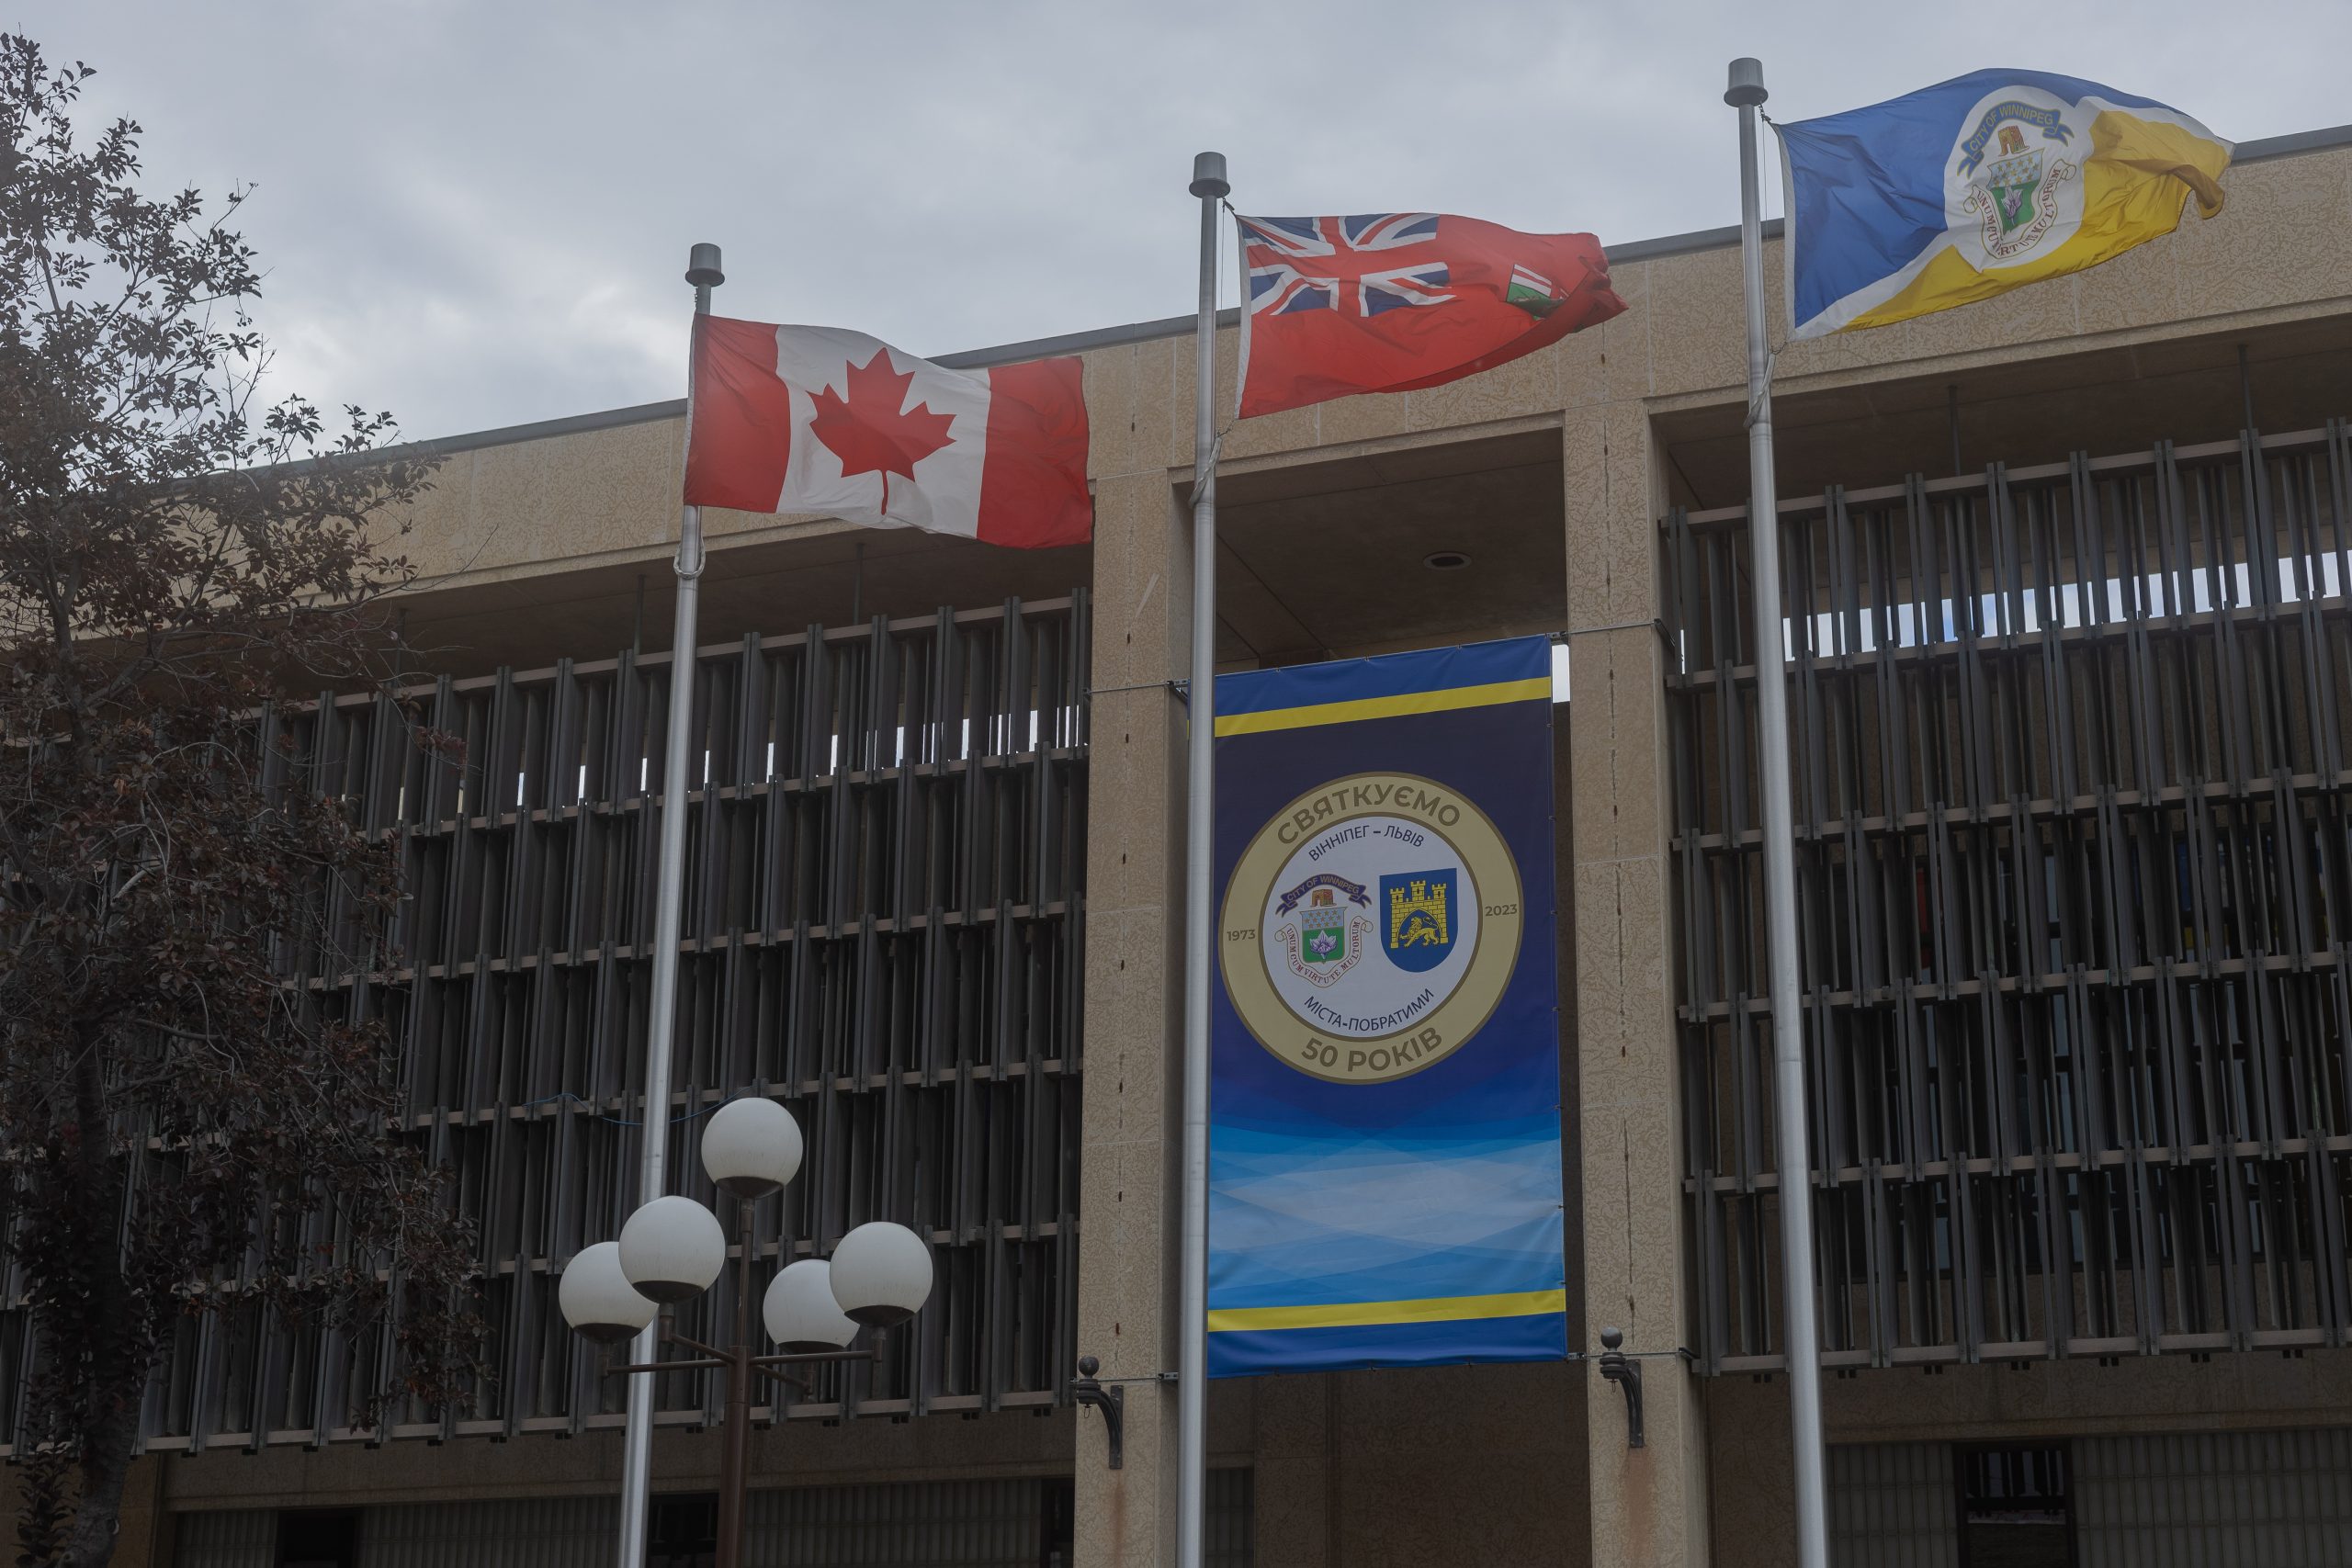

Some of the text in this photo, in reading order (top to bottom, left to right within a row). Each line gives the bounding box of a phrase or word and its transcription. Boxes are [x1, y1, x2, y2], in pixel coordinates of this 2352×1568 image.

[1969, 105, 2053, 152] CITY OF WINNIPEG
[1977, 190, 1996, 225] UNUM
[1277, 784, 1461, 844] СВЯТКУЄМО
[1308, 825, 1370, 862] ВІННІПЕГ
[1384, 825, 1424, 847] ЛЬВІВ
[1287, 875, 1360, 901] CITY OF WINNIPEG
[1485, 903, 1518, 917] 2023
[1227, 929, 1256, 942] 1973
[1286, 921, 1361, 984] UNUM CUM VIRTUTE MULTORUM
[1304, 987, 1434, 1032] МІСТА-ПОБРАТИМИ
[1301, 1027, 1442, 1072] 50 РОКІВ
